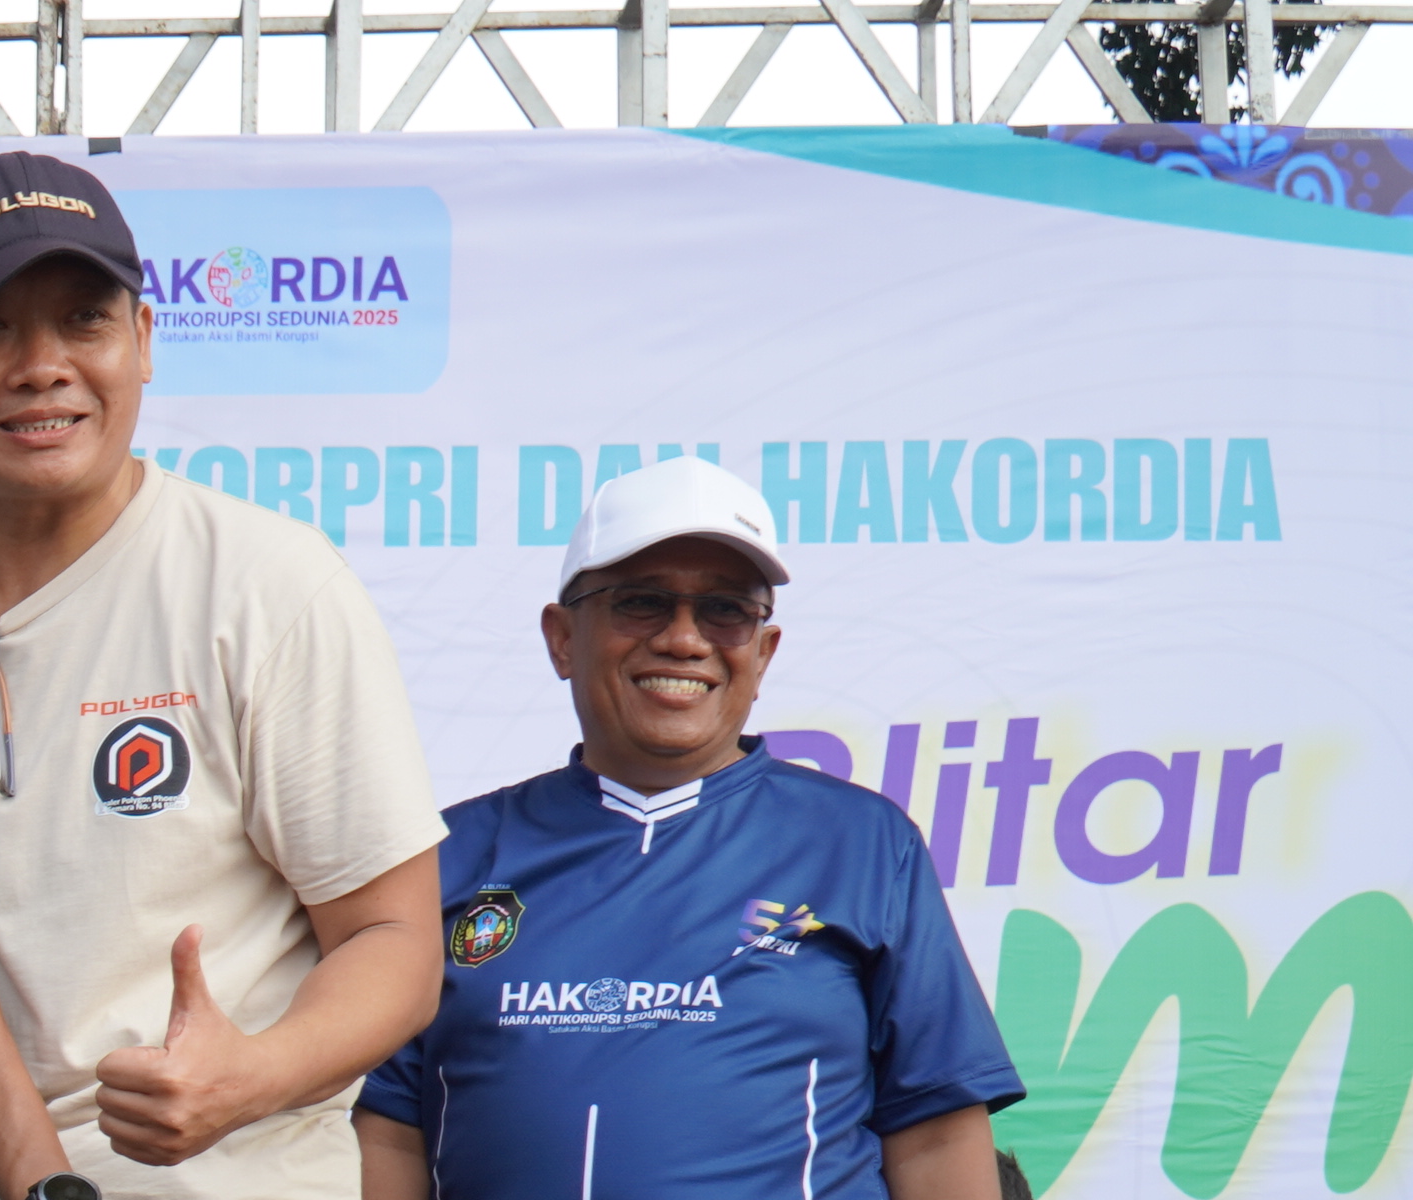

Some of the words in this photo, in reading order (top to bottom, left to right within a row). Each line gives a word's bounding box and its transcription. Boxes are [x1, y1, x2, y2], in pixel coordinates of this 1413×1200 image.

[141, 246, 409, 309] AKORDIA
[152, 311, 261, 328] NTIKORUPSI
[266, 310, 350, 327] SEDUNIA
[353, 309, 399, 326] 2025
[158, 330, 205, 344] Satukan
[208, 331, 234, 343] Aksi
[236, 329, 273, 343] Basmi
[275, 329, 320, 345] Korupsi
[761, 437, 1283, 544] HAKORDIA
[500, 974, 723, 1013] HAKORDIA
[498, 1014, 530, 1027] HARI
[530, 1013, 621, 1026] ANTIKORUPSI
[622, 1008, 681, 1025] SEDUNIA
[681, 1009, 717, 1022] 2025
[581, 1024, 600, 1034] Aksi
